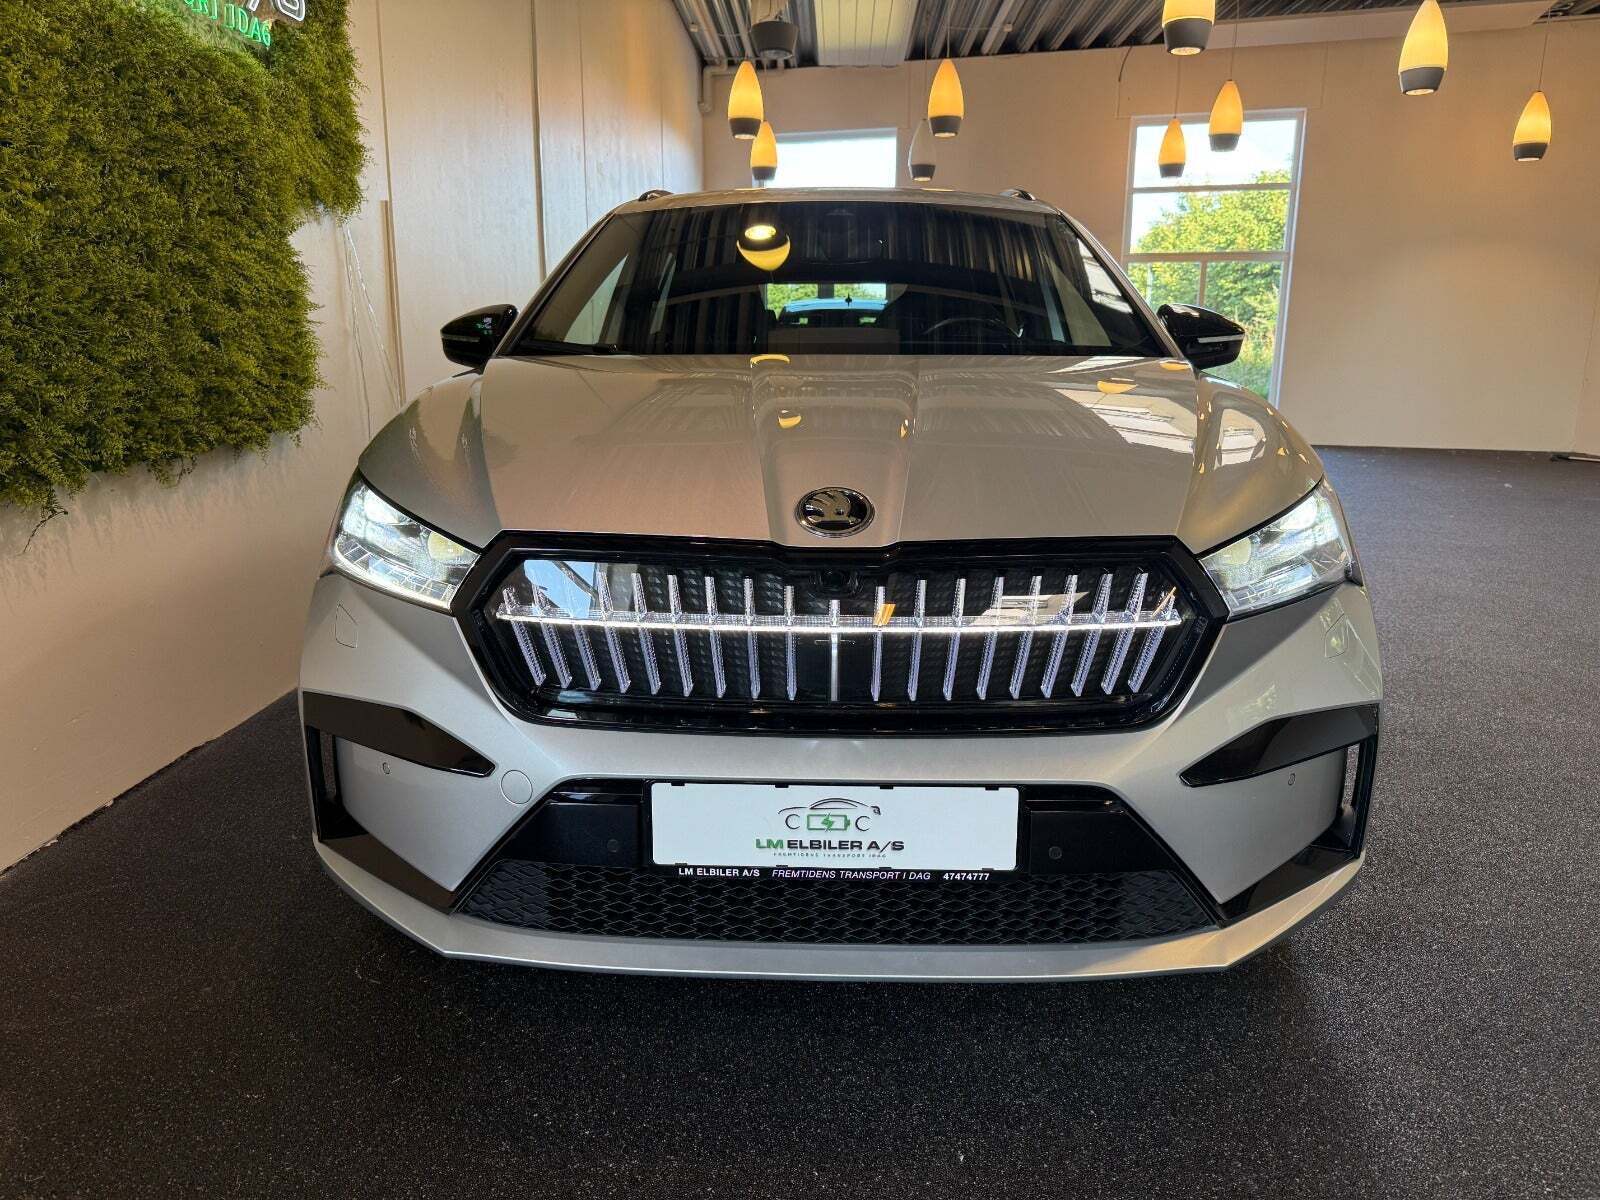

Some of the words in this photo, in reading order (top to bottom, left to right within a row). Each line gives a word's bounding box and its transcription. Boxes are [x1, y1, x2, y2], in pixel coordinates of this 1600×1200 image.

[755, 838, 784, 849] LM
[787, 839, 863, 850] ELBILER
[867, 840, 905, 853] A/S
[678, 867, 694, 876] LM
[696, 868, 739, 877] ELBILER
[742, 868, 760, 877] A/S
[771, 869, 836, 879] FREMTIDENS
[839, 870, 901, 880] TRANSPORT
[908, 871, 931, 880] DAG
[943, 872, 990, 881] 47474777
